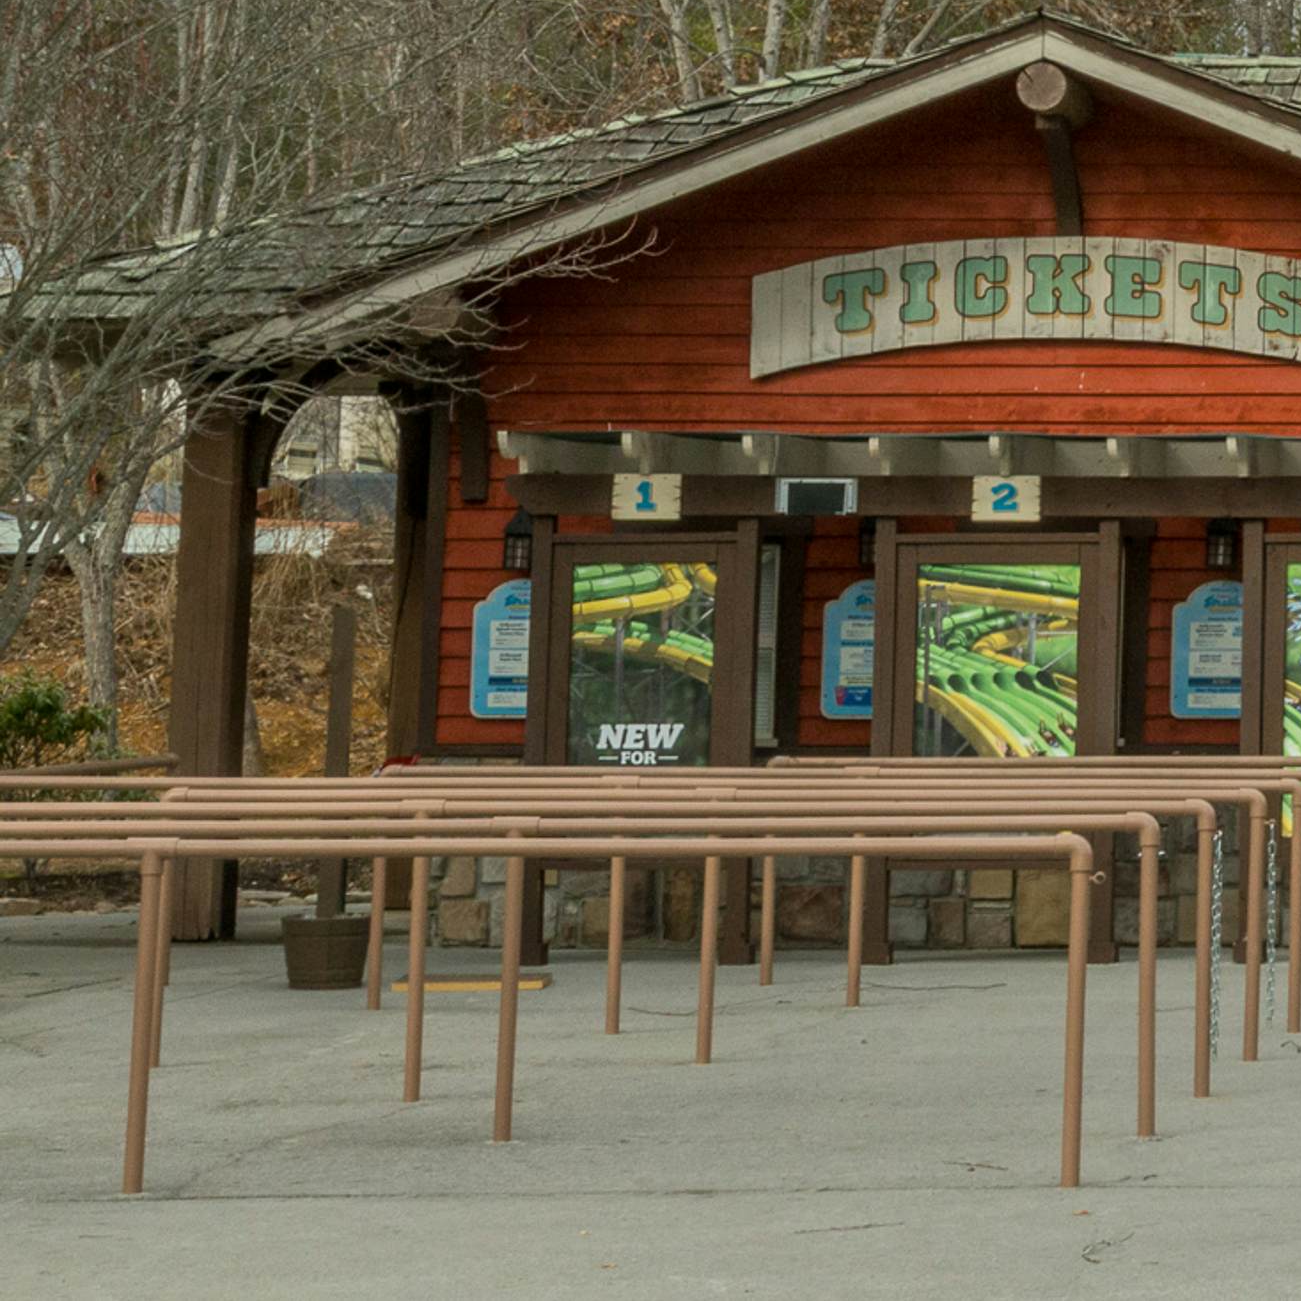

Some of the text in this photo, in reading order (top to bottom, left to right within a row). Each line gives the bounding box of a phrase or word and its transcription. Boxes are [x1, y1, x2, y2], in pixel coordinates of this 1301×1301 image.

[635, 482, 657, 511] 1
[991, 482, 1018, 511] 2
[596, 724, 684, 749] NEW
[621, 751, 656, 765] FOR
